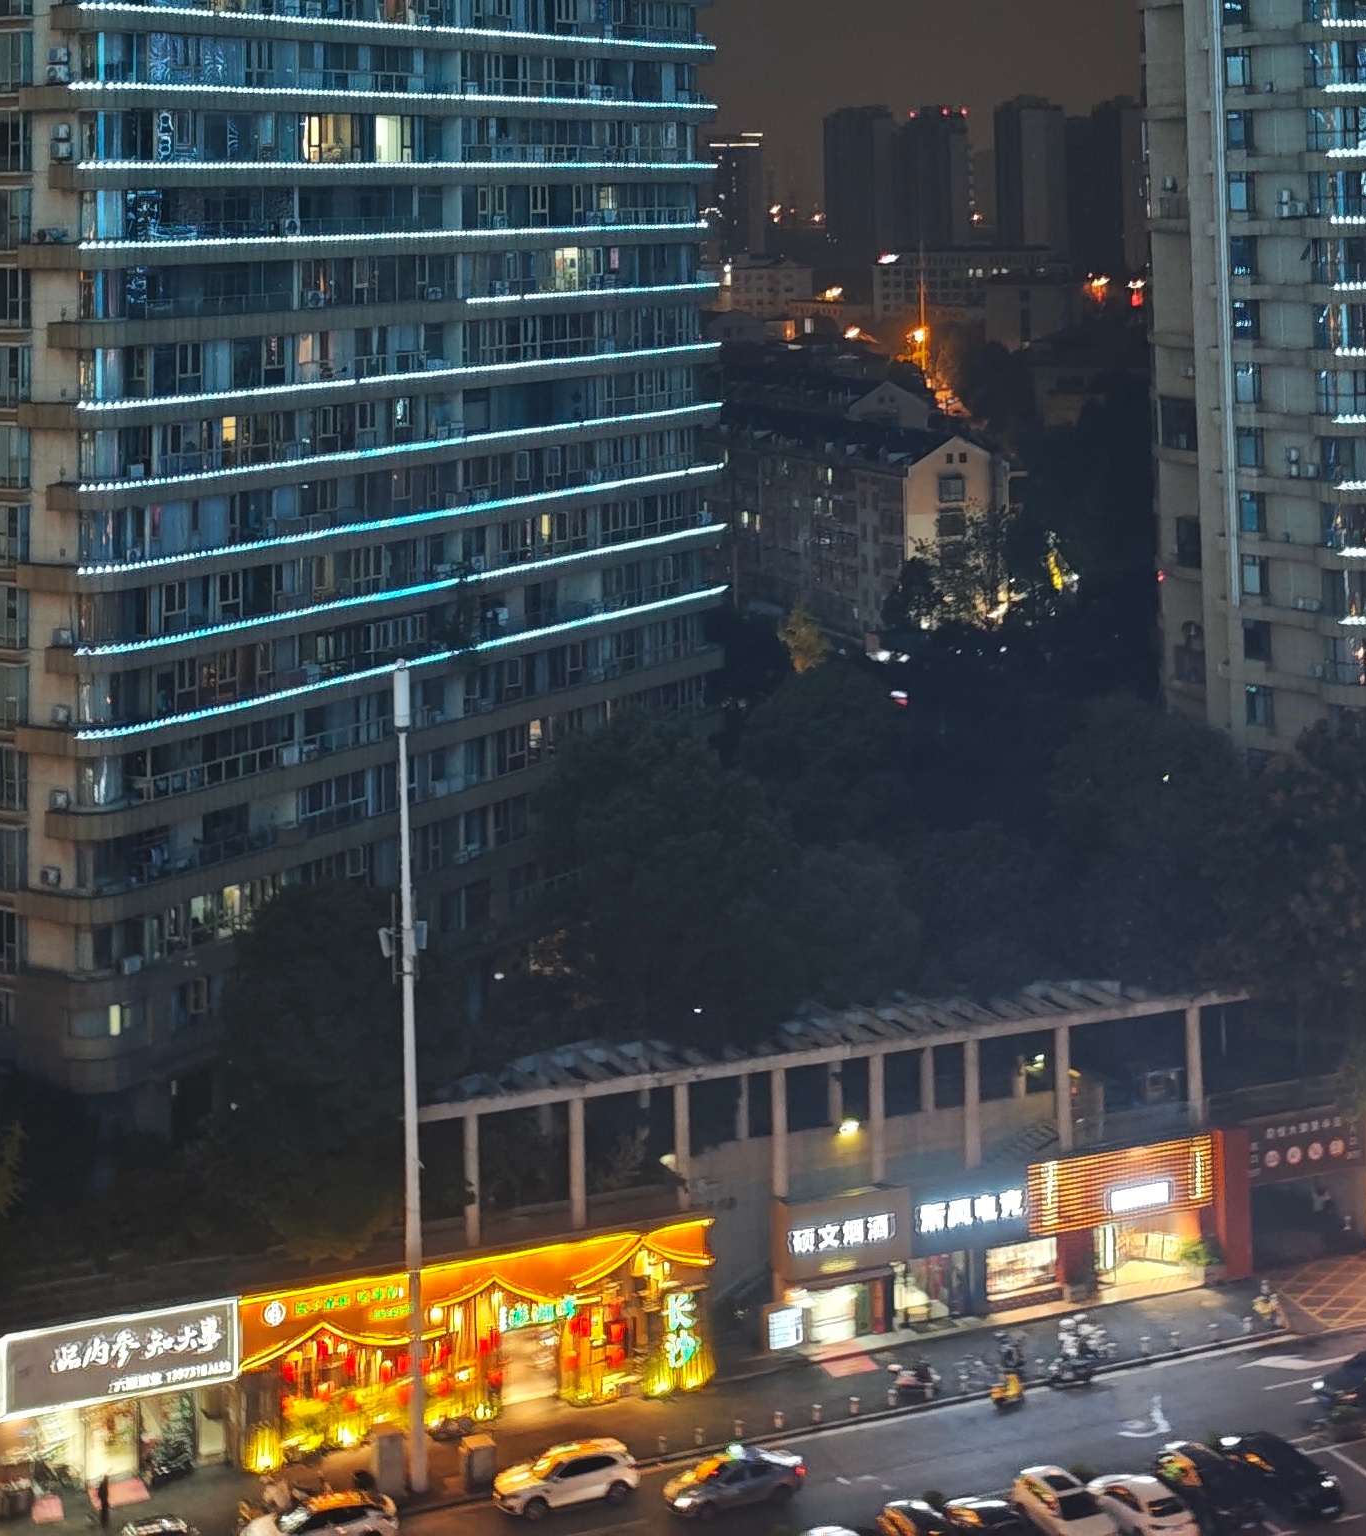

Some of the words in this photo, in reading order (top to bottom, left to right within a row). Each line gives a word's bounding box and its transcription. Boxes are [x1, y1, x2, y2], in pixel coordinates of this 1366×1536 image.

[792, 1213, 891, 1253] 硕文烟酒
[662, 1292, 702, 1368] 长沙
